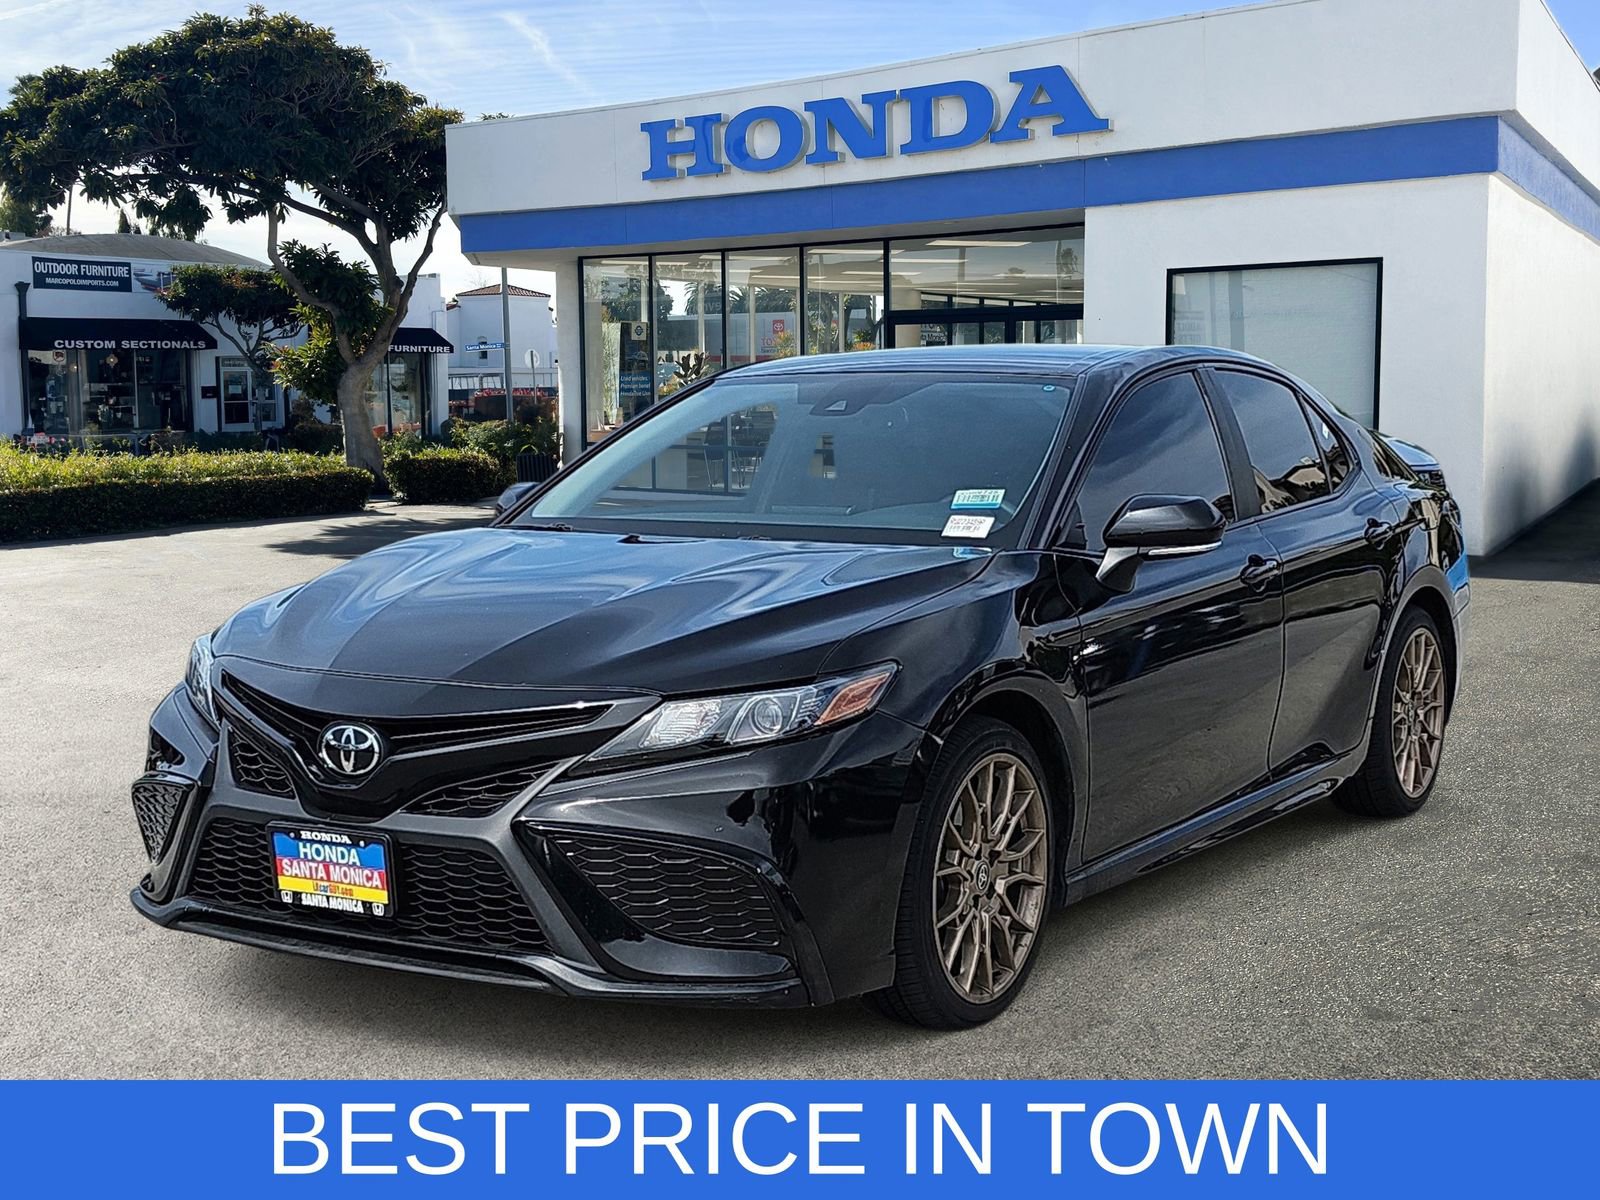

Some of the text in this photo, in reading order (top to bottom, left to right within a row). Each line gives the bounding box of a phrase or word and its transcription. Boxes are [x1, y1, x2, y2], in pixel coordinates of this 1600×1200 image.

[640, 65, 1115, 181] HONDA
[34, 261, 130, 278] OUTDOOR FURNITURE
[45, 277, 119, 287] MARCOPOLOIMPORTS.COM
[54, 339, 206, 349] CUSTOM SECTIONALS
[388, 344, 450, 353] FURNITURE
[300, 830, 352, 844] HONDA
[298, 842, 360, 866] HONDA
[282, 858, 381, 888] SANTA MONICA
[301, 892, 365, 913] SANTA MONICA
